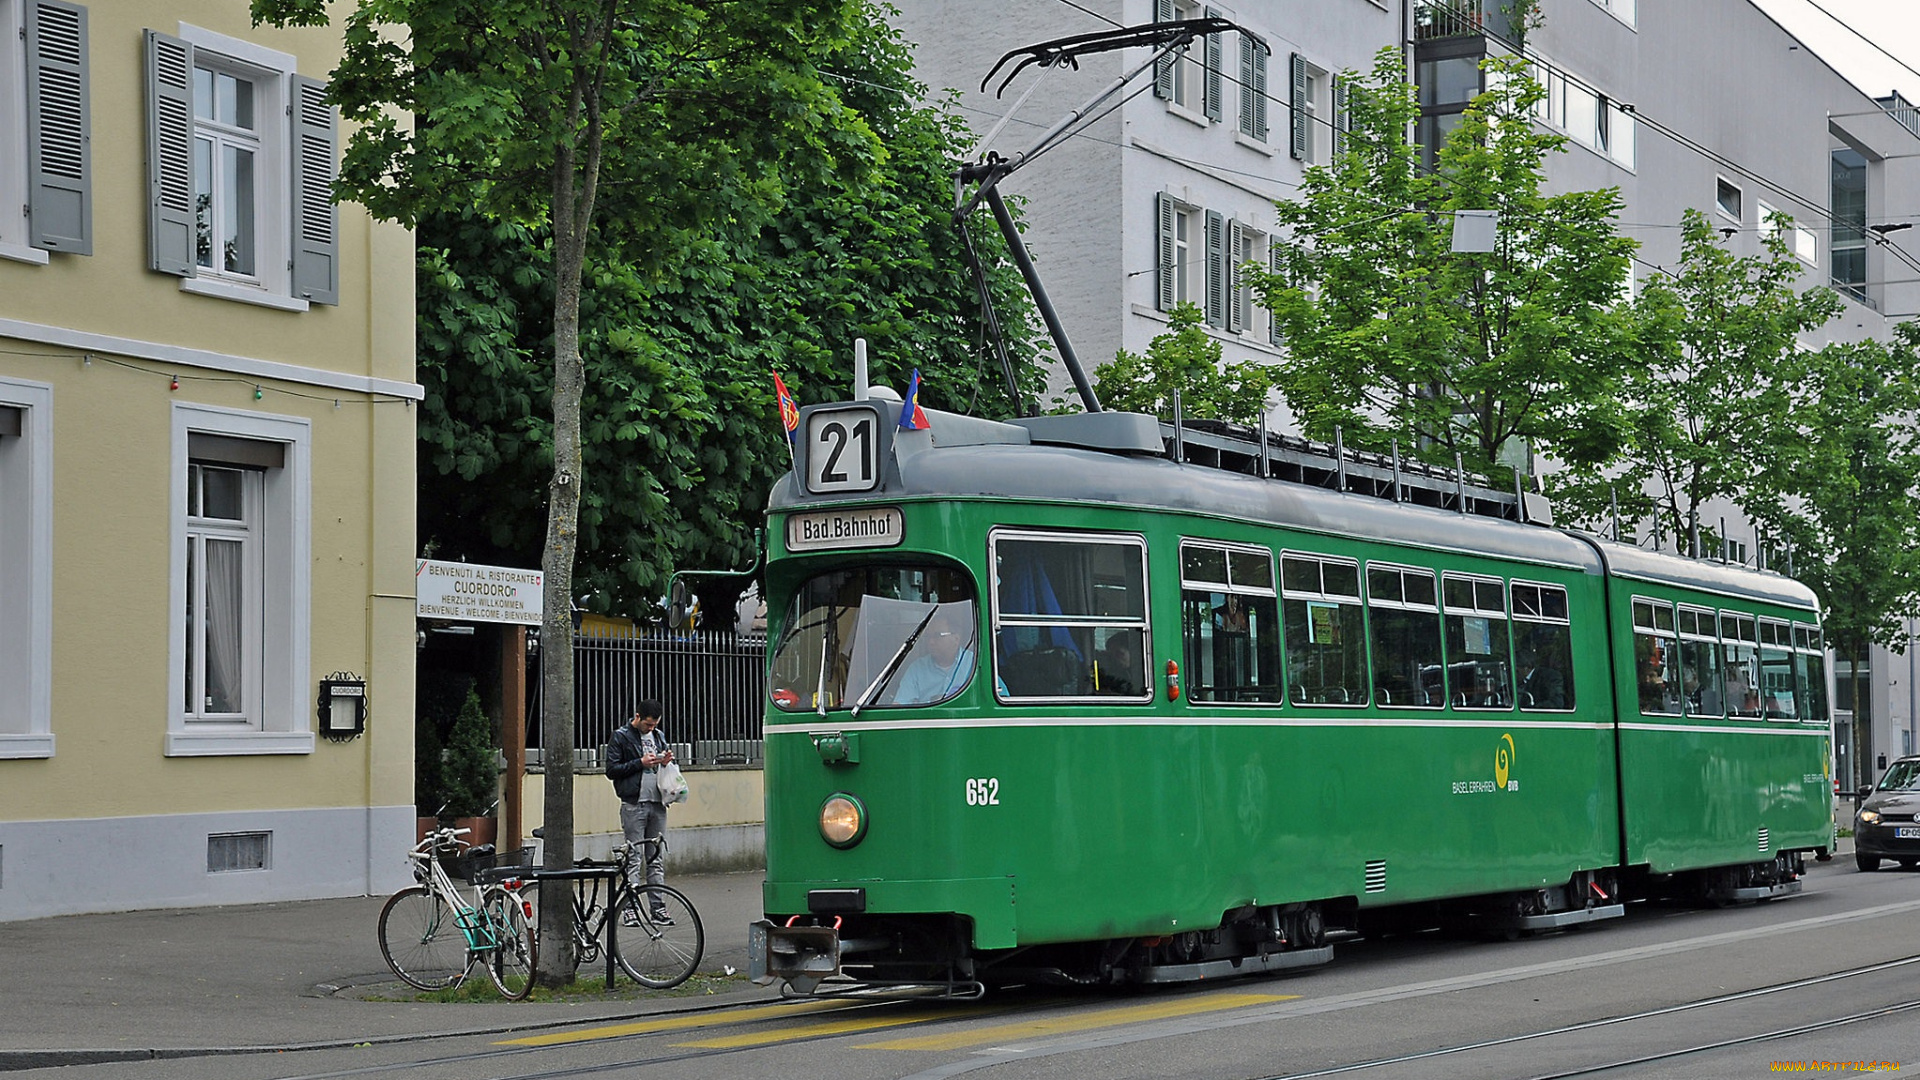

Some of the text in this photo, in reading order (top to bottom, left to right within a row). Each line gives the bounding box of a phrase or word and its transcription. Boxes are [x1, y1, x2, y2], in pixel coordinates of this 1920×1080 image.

[820, 419, 872, 483] 21
[429, 565, 535, 584] BENVENUTI AL RISTORANTE
[442, 595, 524, 609] HERZLICH WILLKOMMEN
[420, 604, 459, 616] BIENVENUE
[466, 608, 500, 618] WELCOME
[966, 777, 1000, 806] 652
[1452, 781, 1469, 794] BASEL
